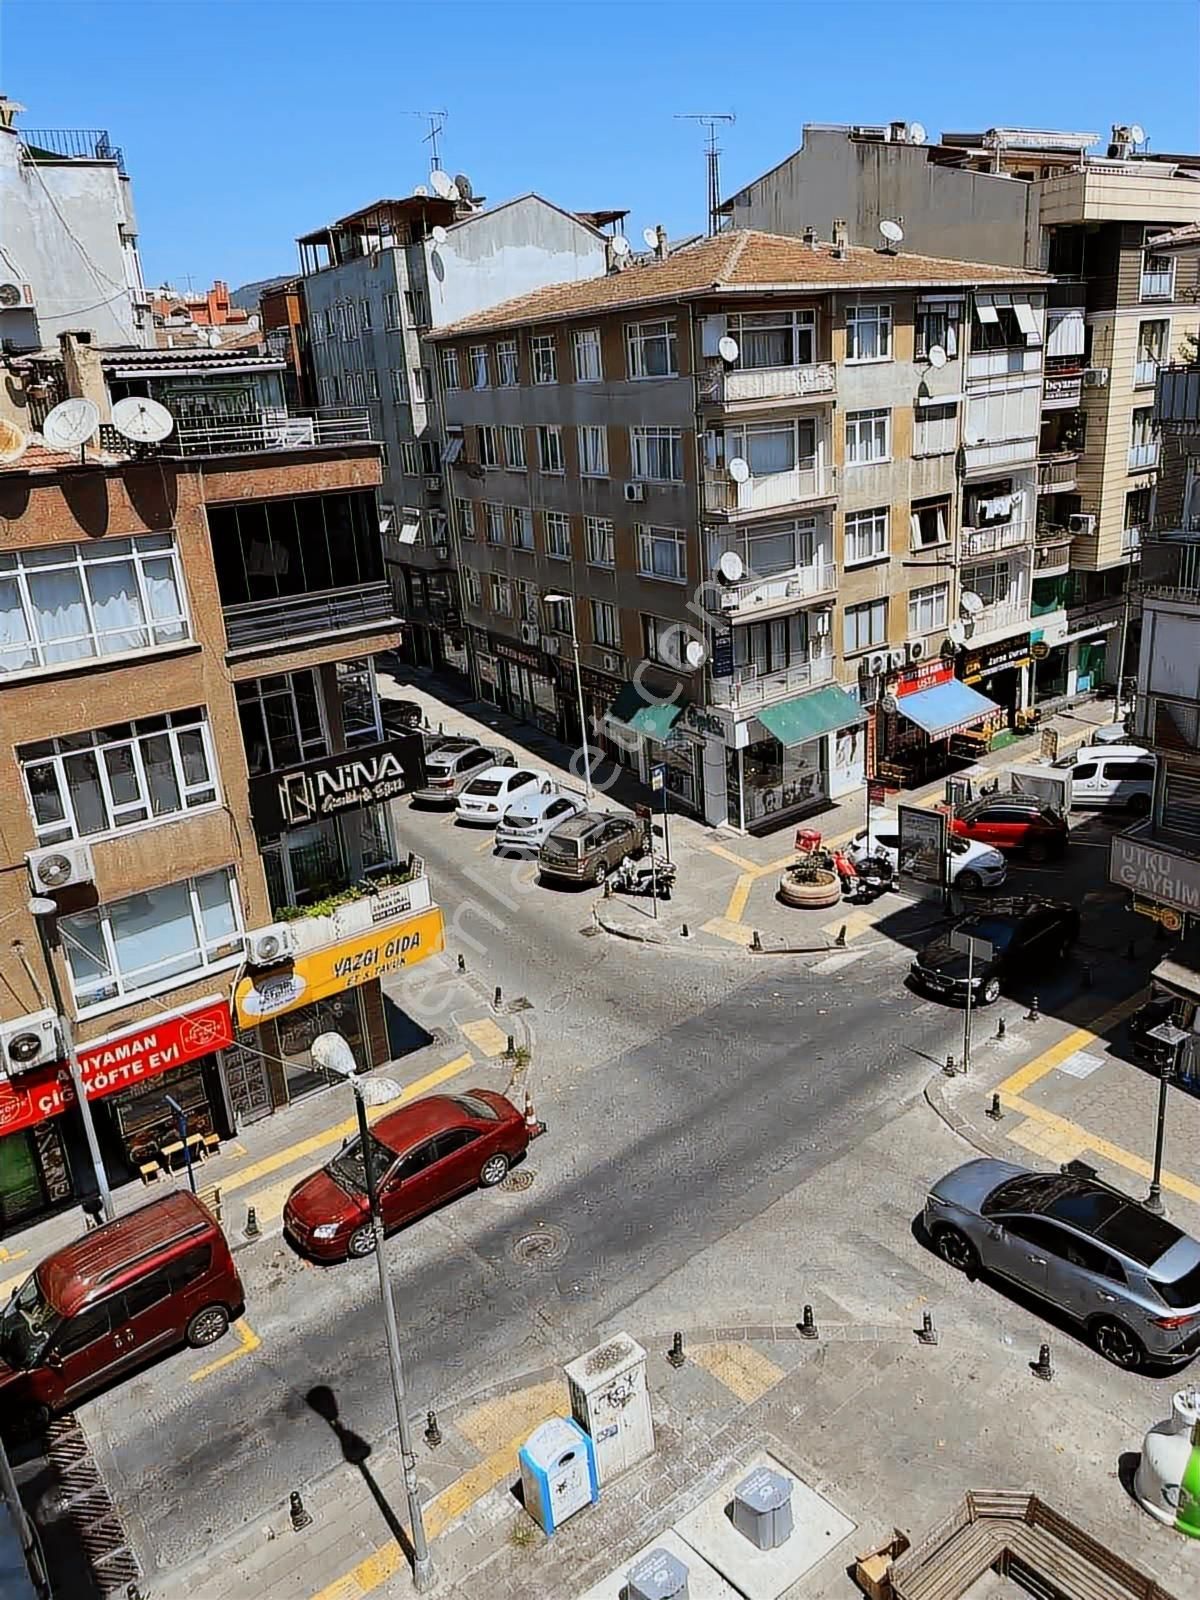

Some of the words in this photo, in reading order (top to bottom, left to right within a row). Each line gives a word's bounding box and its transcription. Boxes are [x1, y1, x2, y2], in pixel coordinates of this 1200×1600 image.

[334, 947, 379, 979] YAZGI
[384, 931, 420, 959] GIDA
[82, 1060, 145, 1097] KÖFTE
[150, 1042, 179, 1067] EVİ
